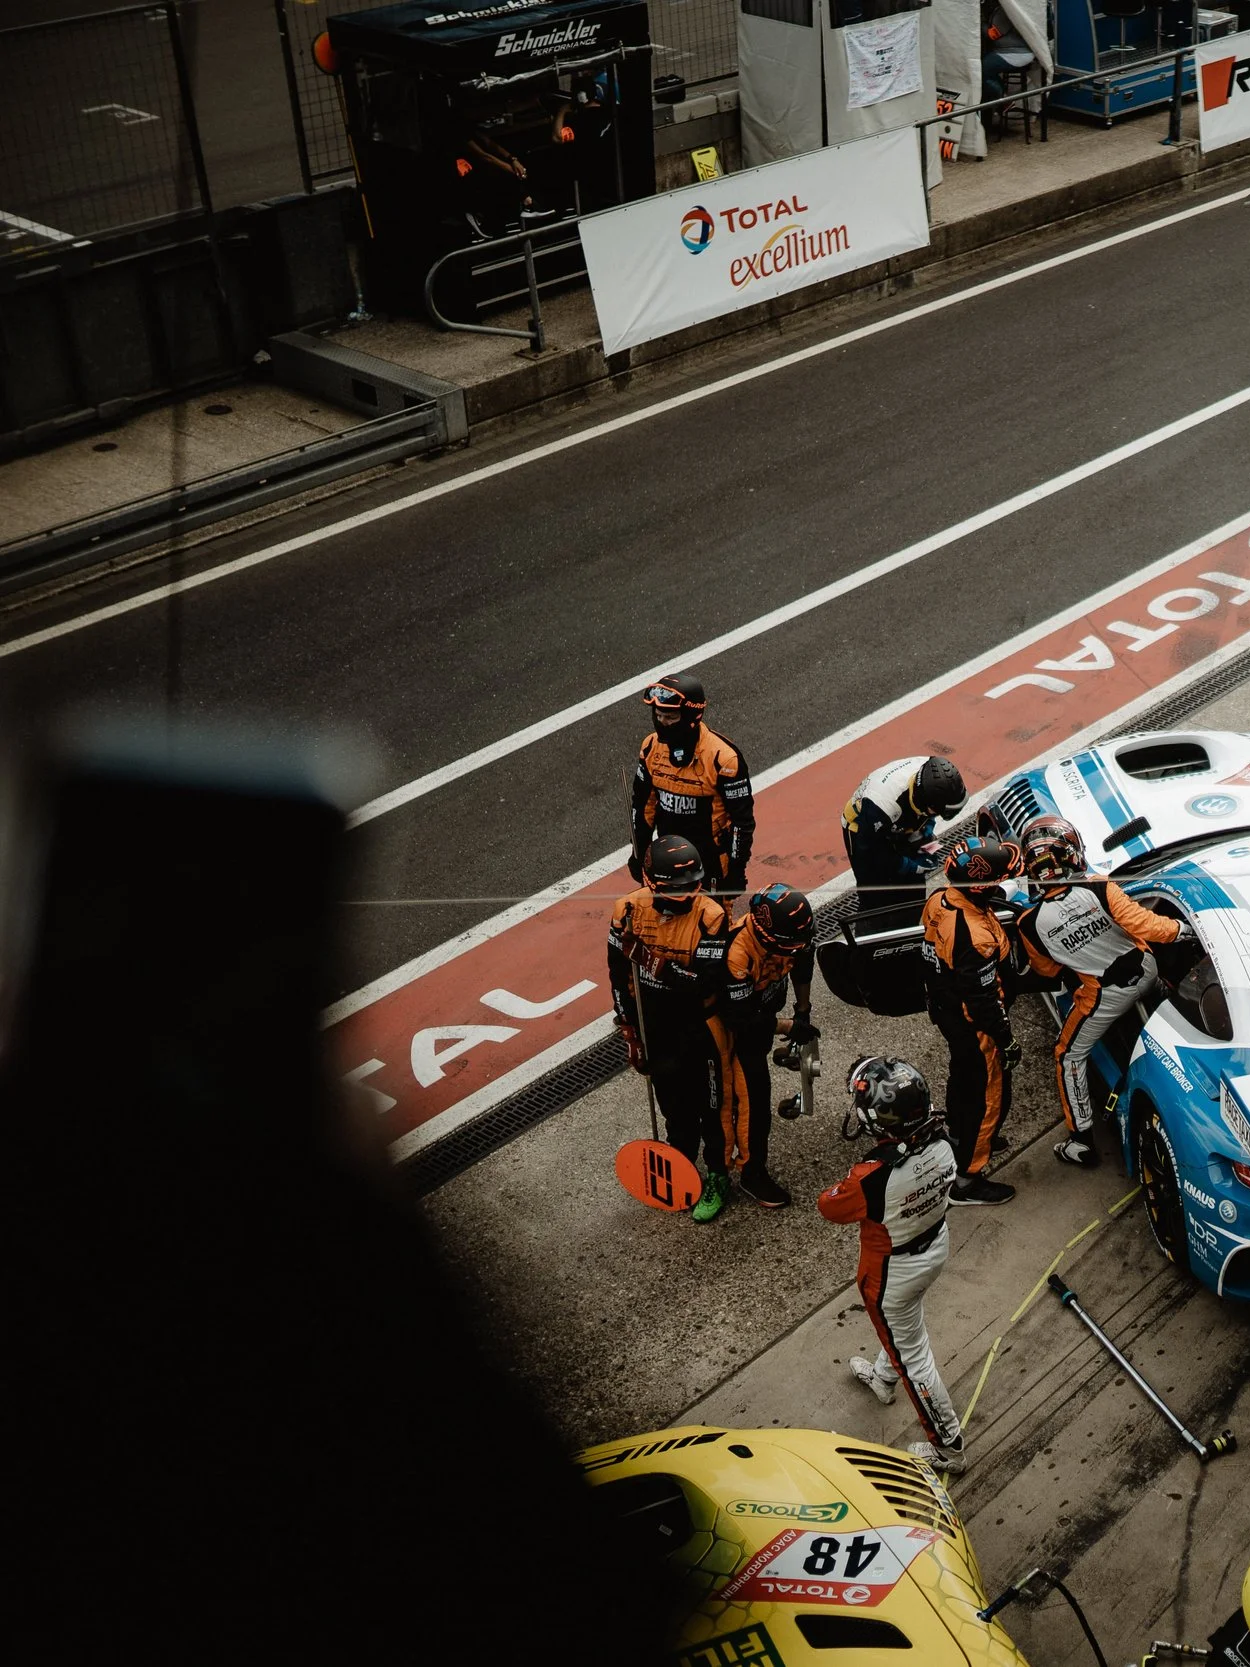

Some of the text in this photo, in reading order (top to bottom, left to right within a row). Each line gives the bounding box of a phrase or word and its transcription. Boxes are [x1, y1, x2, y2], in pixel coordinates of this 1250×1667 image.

[495, 18, 602, 57] Schmickler
[530, 37, 598, 57] PERFORMANCE
[720, 195, 809, 233] TOTAL
[730, 224, 850, 287] excellium
[1148, 1039, 1164, 1058] EXPERT
[1170, 1066, 1193, 1094] BROKER
[1183, 1180, 1216, 1210] KNAUS
[720, 1530, 797, 1600] ADAC NORDRHEIN
[803, 1535, 881, 1579] 48
[761, 1583, 838, 1599] TOTAL
